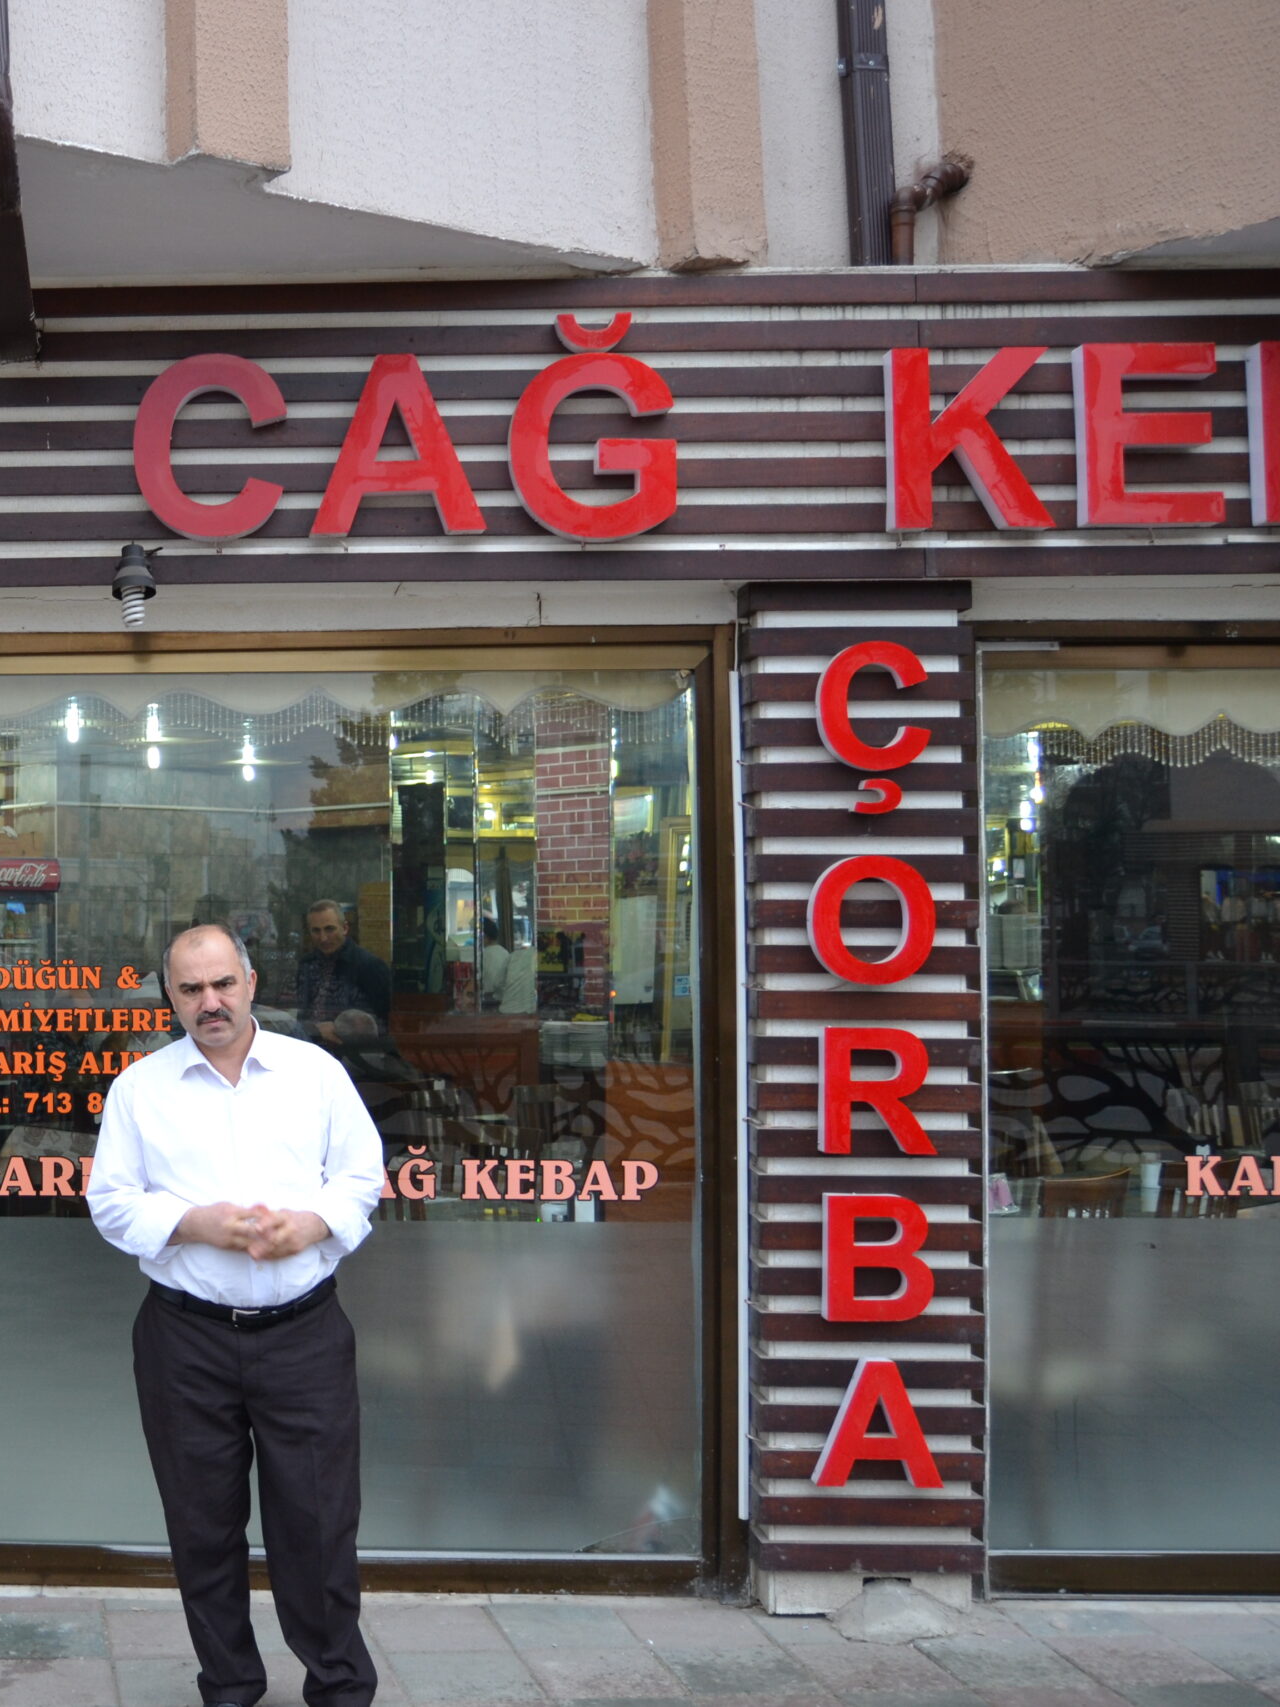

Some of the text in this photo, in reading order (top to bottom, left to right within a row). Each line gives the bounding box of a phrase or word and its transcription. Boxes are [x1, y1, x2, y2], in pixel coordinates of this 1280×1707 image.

[133, 311, 678, 543] CAĞ
[882, 340, 1280, 533] KE
[116, 965, 142, 990] &
[806, 640, 945, 1490] ÇORBA
[24, 1092, 73, 1114] 713
[460, 1158, 660, 1202] KEBAP
